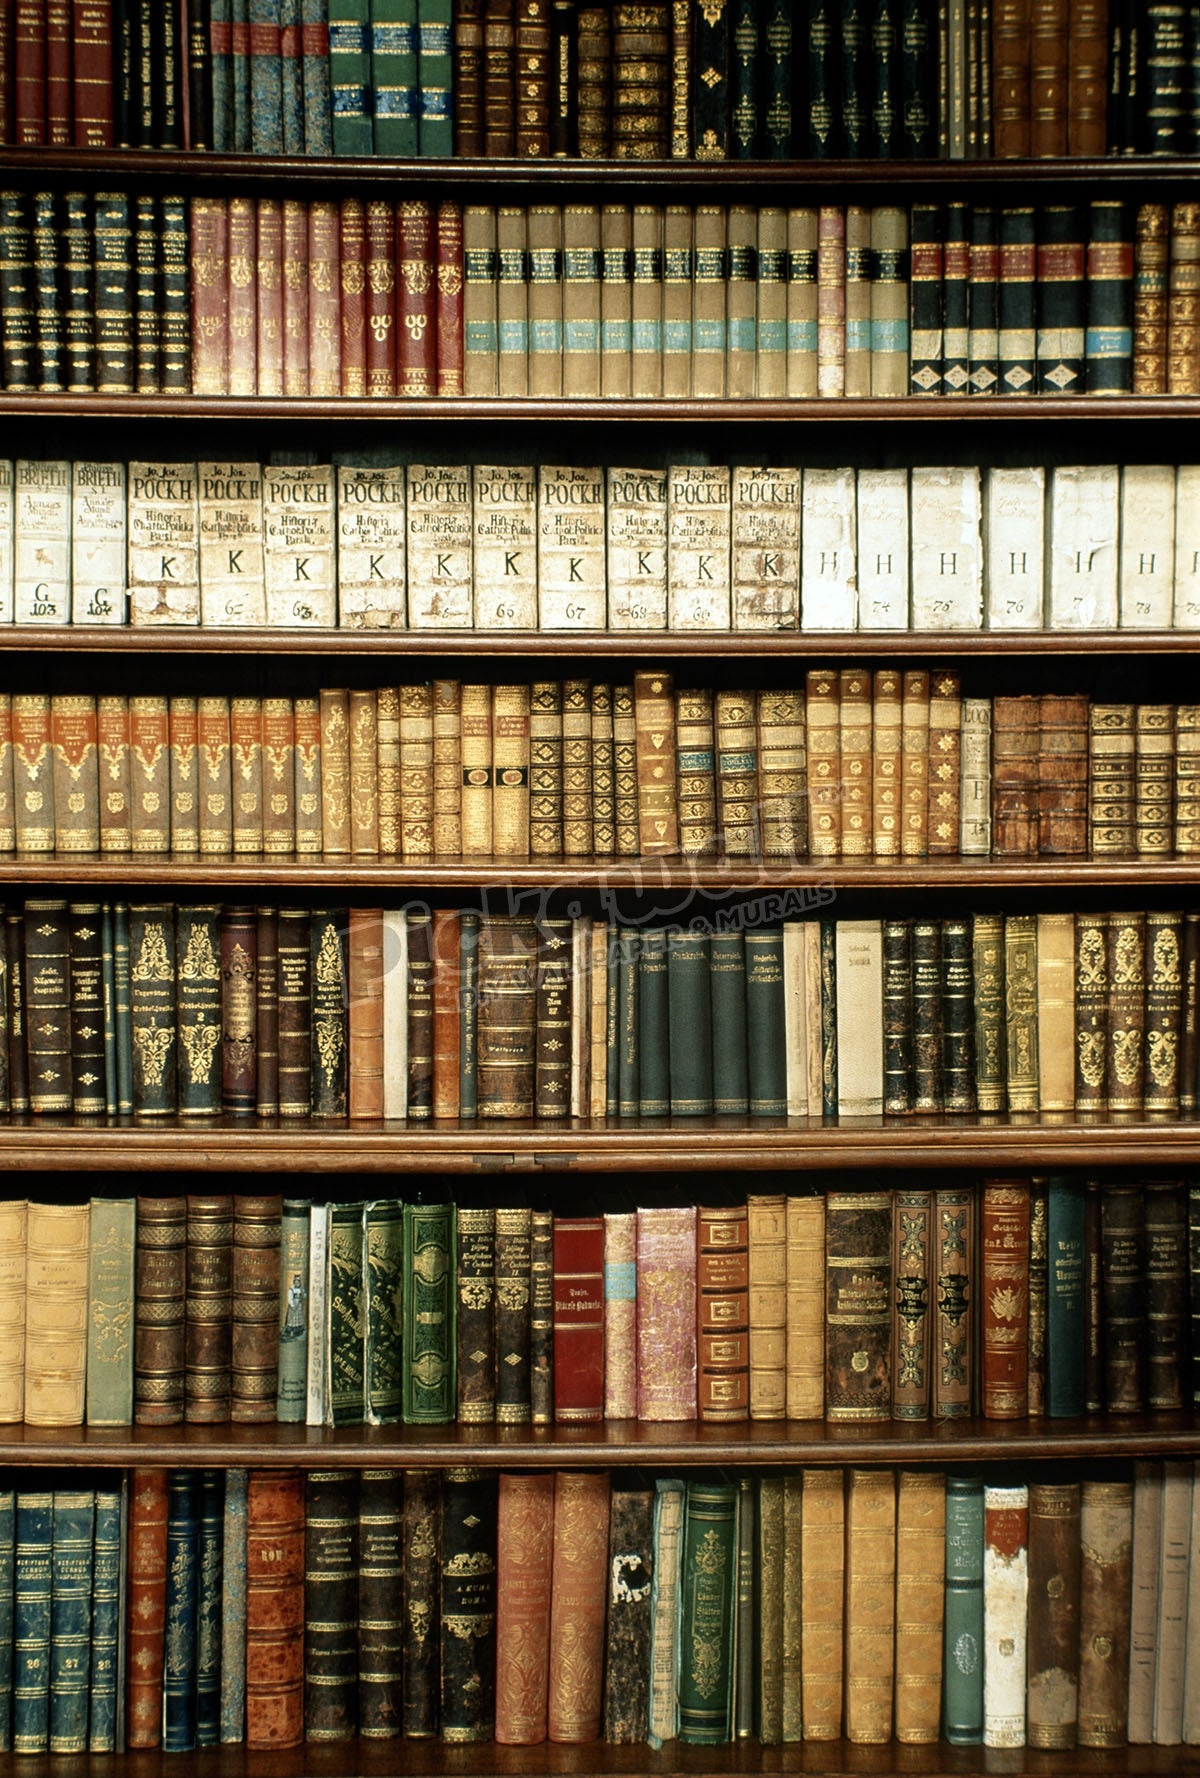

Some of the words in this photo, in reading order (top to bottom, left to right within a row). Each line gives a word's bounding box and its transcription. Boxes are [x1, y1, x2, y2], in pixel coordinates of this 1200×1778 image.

[133, 478, 193, 499] POCKH
[204, 479, 260, 500] POCKH
[270, 483, 327, 504] POCKH
[343, 483, 401, 504] POCKH
[411, 482, 467, 504] POCKH
[479, 483, 534, 504] POCKH
[544, 484, 601, 506] POCKH
[673, 483, 728, 505] POCKH
[738, 483, 796, 505] POCKH
[162, 556, 180, 577] K
[228, 550, 246, 573] K
[294, 558, 312, 581] K
[369, 555, 387, 580] K
[436, 554, 453, 577] K
[504, 552, 521, 577] K
[569, 558, 585, 582] K
[638, 552, 653, 575] K
[698, 556, 714, 580] K
[762, 553, 781, 577] K
[819, 551, 837, 577] H
[875, 554, 892, 576] H
[939, 552, 958, 576] H
[1008, 552, 1027, 576] H
[1137, 553, 1155, 576] H
[565, 603, 587, 620] 67
[1006, 600, 1024, 614] 76
[150, 1016, 156, 1026] 1
[197, 1011, 205, 1022] 2
[1091, 1016, 1097, 1026] 1
[1125, 1015, 1133, 1025] 2
[1161, 1017, 1170, 1027] 3
[26, 1658, 40, 1670] 26
[65, 1658, 79, 1669] 27
[97, 1659, 111, 1671] 28
